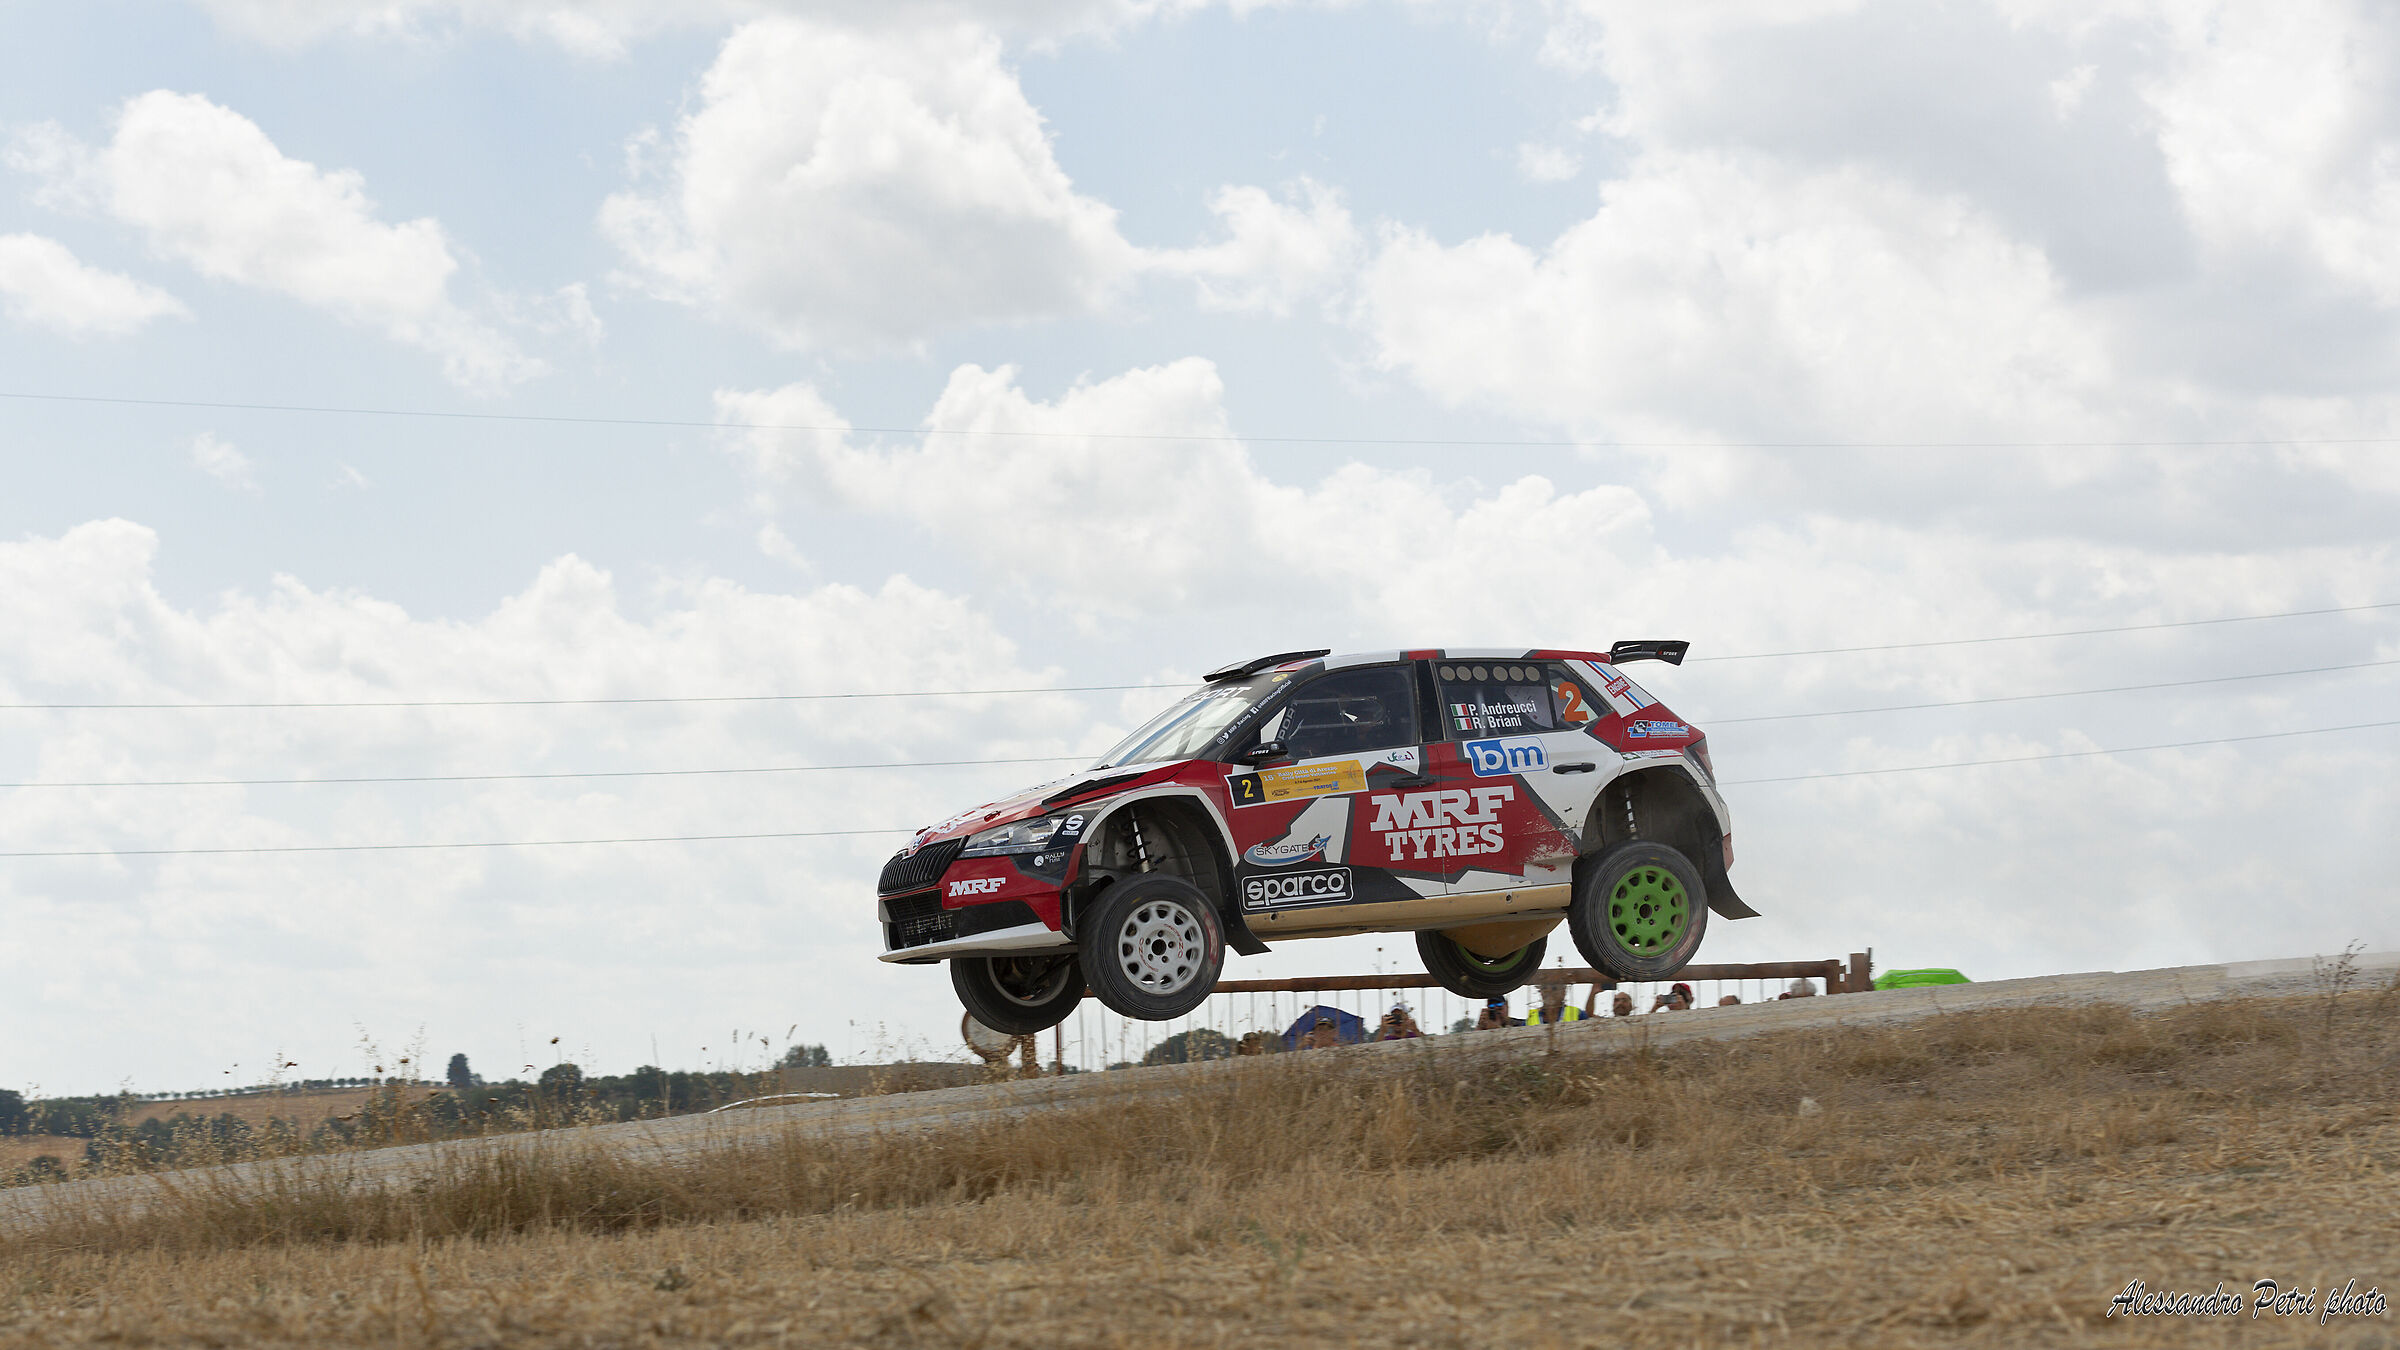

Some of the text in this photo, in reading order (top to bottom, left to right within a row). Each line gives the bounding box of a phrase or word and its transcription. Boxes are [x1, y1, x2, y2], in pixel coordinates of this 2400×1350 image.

[1468, 700, 1537, 717] P. Andreucci
[1558, 682, 1589, 722] 2
[1472, 714, 1522, 730] R. Briani
[1472, 745, 1544, 771] bm
[1241, 779, 1254, 798] 2
[1370, 785, 1515, 832] MRF
[1256, 843, 1308, 856] SKYGATE
[1385, 823, 1504, 862] TYRES
[948, 877, 1007, 897] MRF
[1247, 873, 1345, 906] sparco
